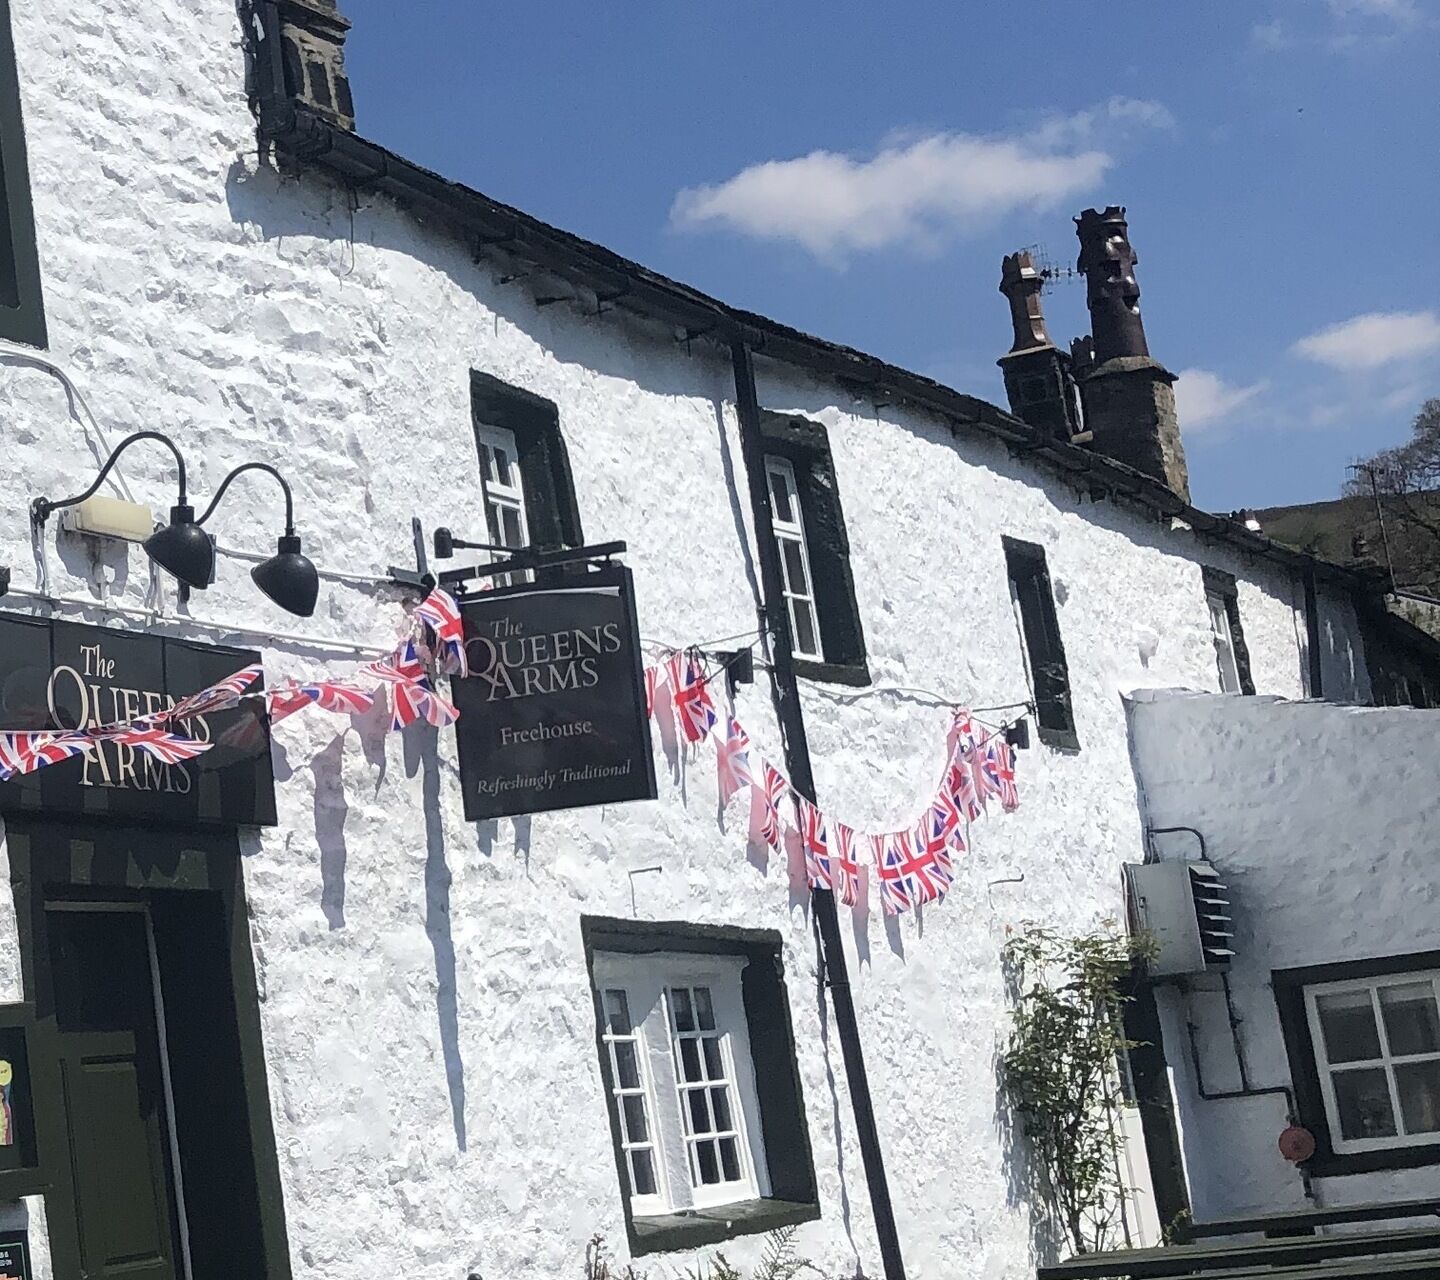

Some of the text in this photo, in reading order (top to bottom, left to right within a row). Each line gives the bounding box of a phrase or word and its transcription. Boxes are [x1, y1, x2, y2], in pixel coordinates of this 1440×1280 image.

[490, 617, 523, 638] The
[80, 644, 115, 678] The
[463, 623, 621, 686] QUEENS
[486, 658, 599, 702] ARMS
[501, 721, 592, 746] Freehouse
[477, 759, 631, 797] Refreshingly Traditional
